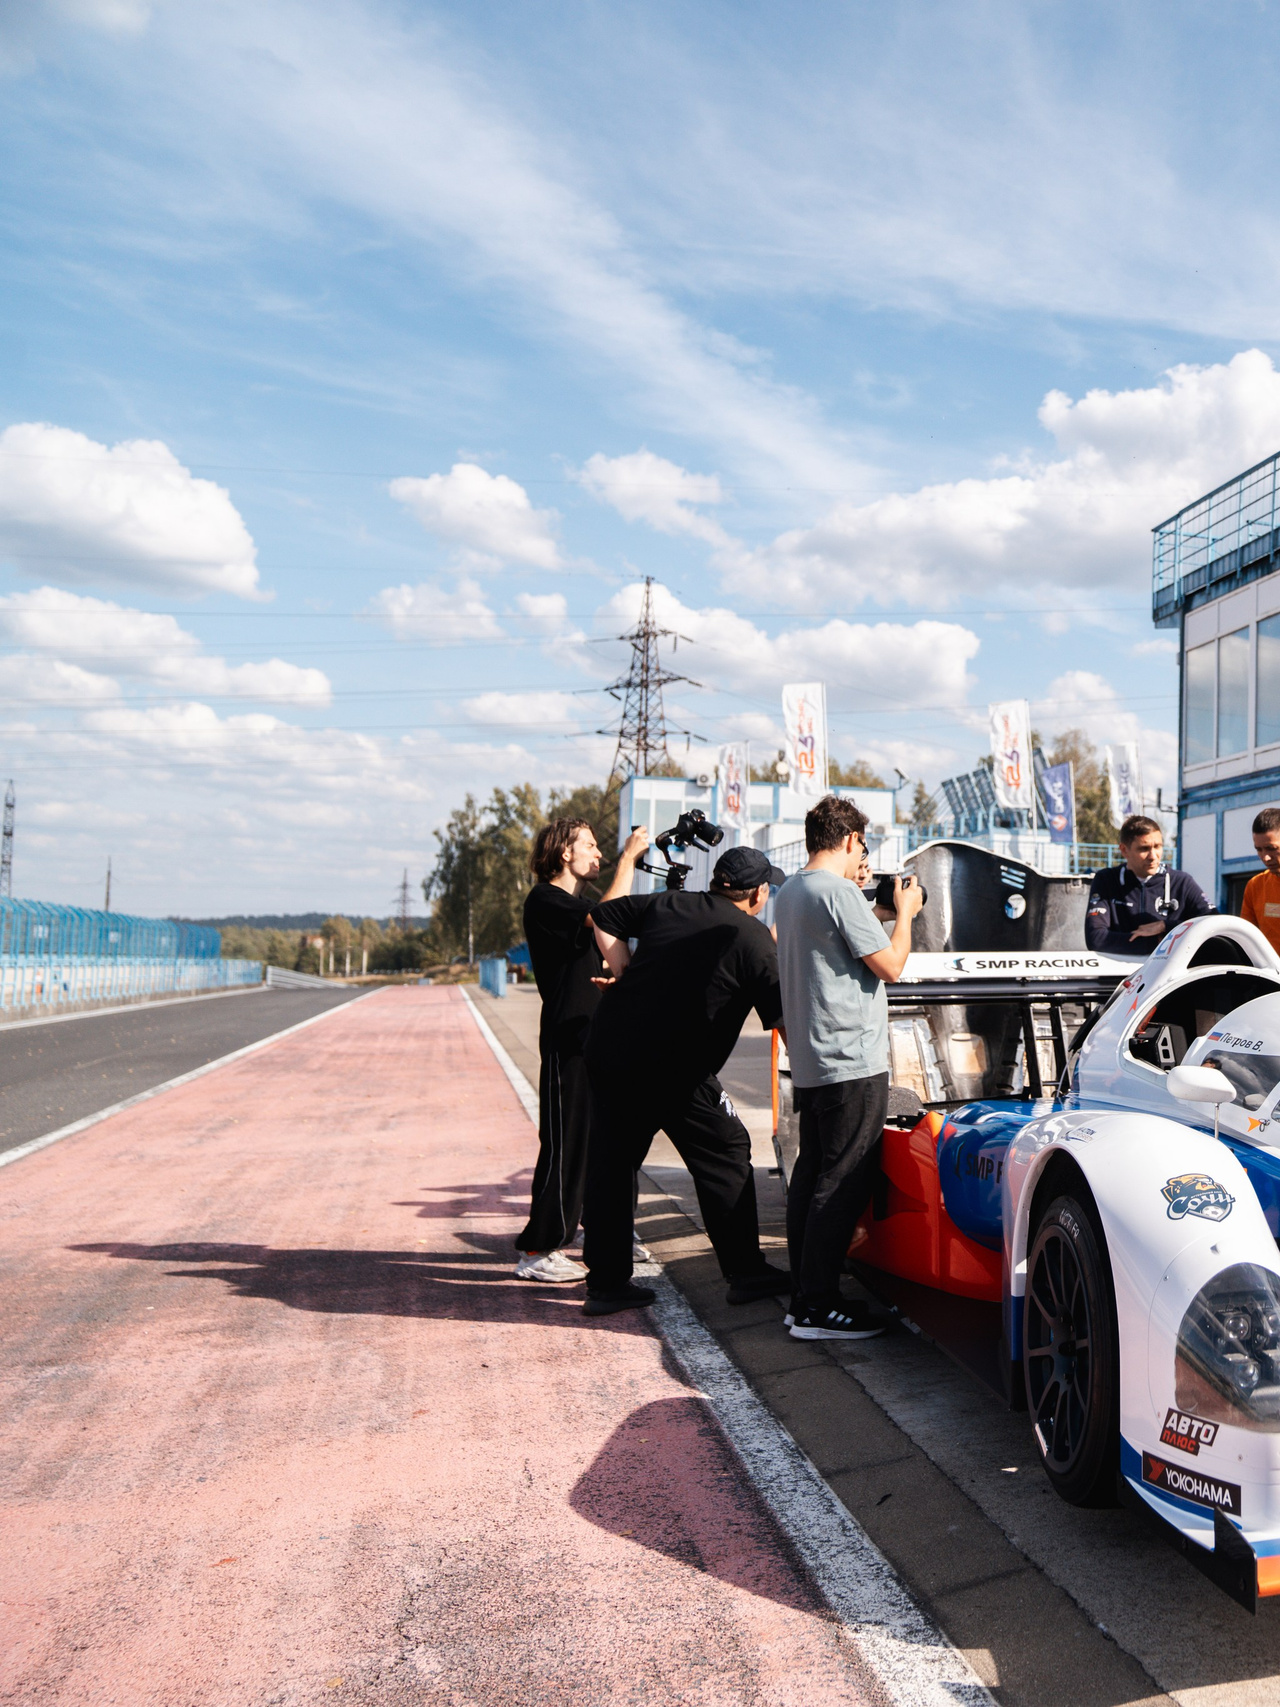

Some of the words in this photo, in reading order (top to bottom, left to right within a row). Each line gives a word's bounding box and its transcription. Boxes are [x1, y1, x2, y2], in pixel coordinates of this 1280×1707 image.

[976, 960, 1020, 969] SMP
[1025, 958, 1100, 968] RACING
[1220, 1032, 1253, 1047] Петров
[965, 1152, 994, 1180] SMP
[1165, 1412, 1215, 1443] АВТО
[1162, 1429, 1197, 1452] ПЛЮС
[1165, 1467, 1233, 1508] YOKOHAMA
